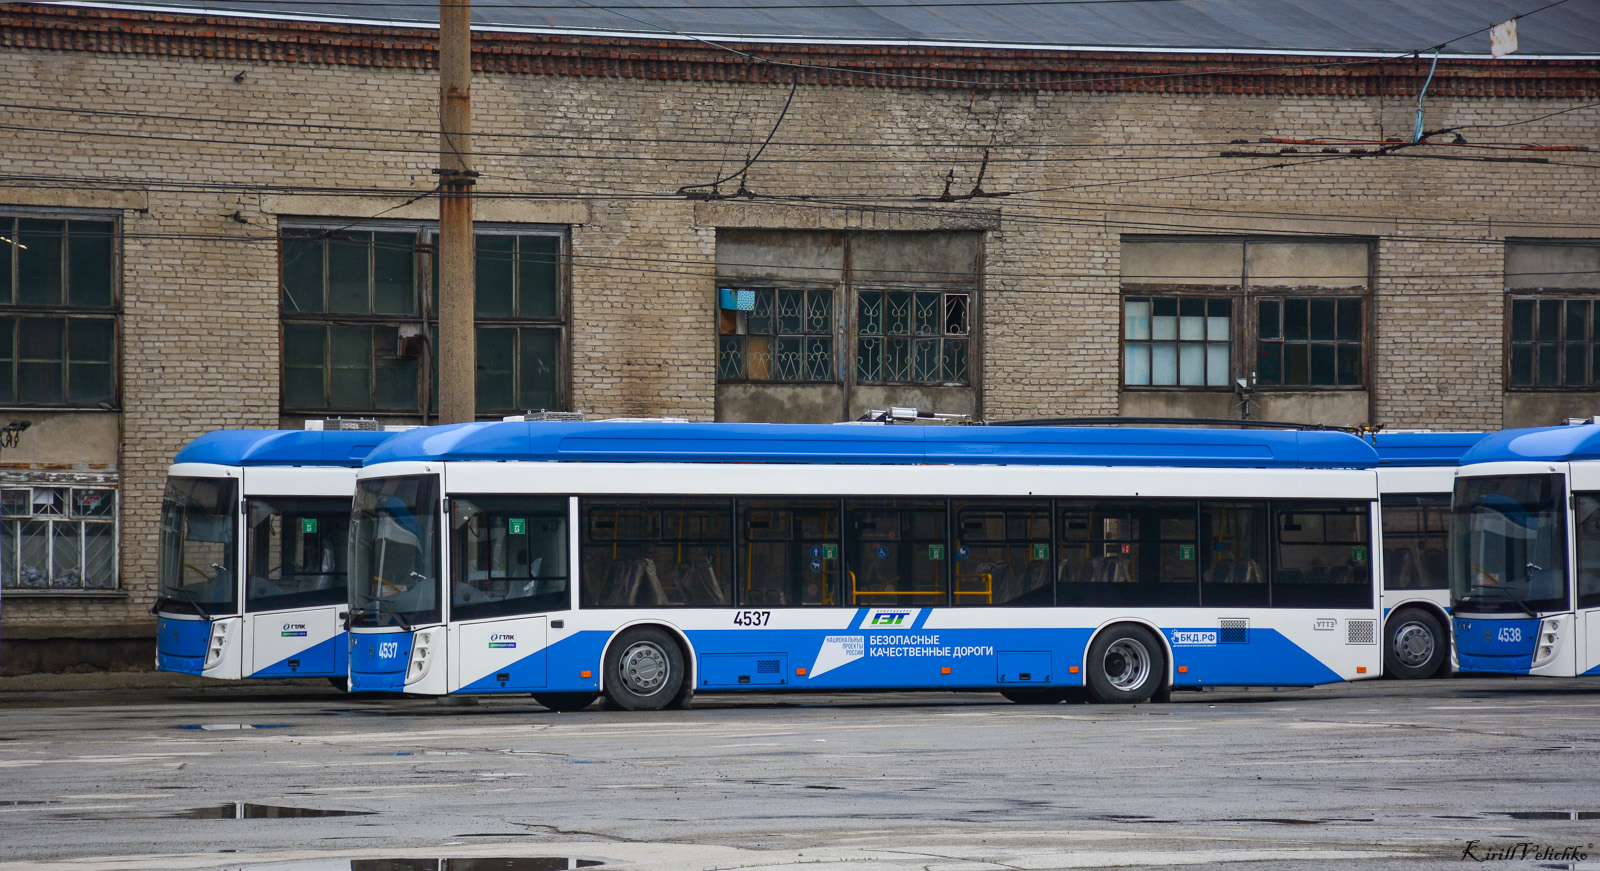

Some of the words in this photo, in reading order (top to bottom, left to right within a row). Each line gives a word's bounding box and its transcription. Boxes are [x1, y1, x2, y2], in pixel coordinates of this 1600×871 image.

[733, 611, 771, 626] 4537
[869, 635, 940, 645] БЕЗОПАСНЫЕ
[1180, 633, 1216, 643] БКД.РФ
[1497, 627, 1522, 643] 4538
[378, 642, 398, 659] 4537
[869, 647, 951, 657] КАЧЕСТВЕННЫЕ
[952, 646, 994, 658] ДОРОГИ
